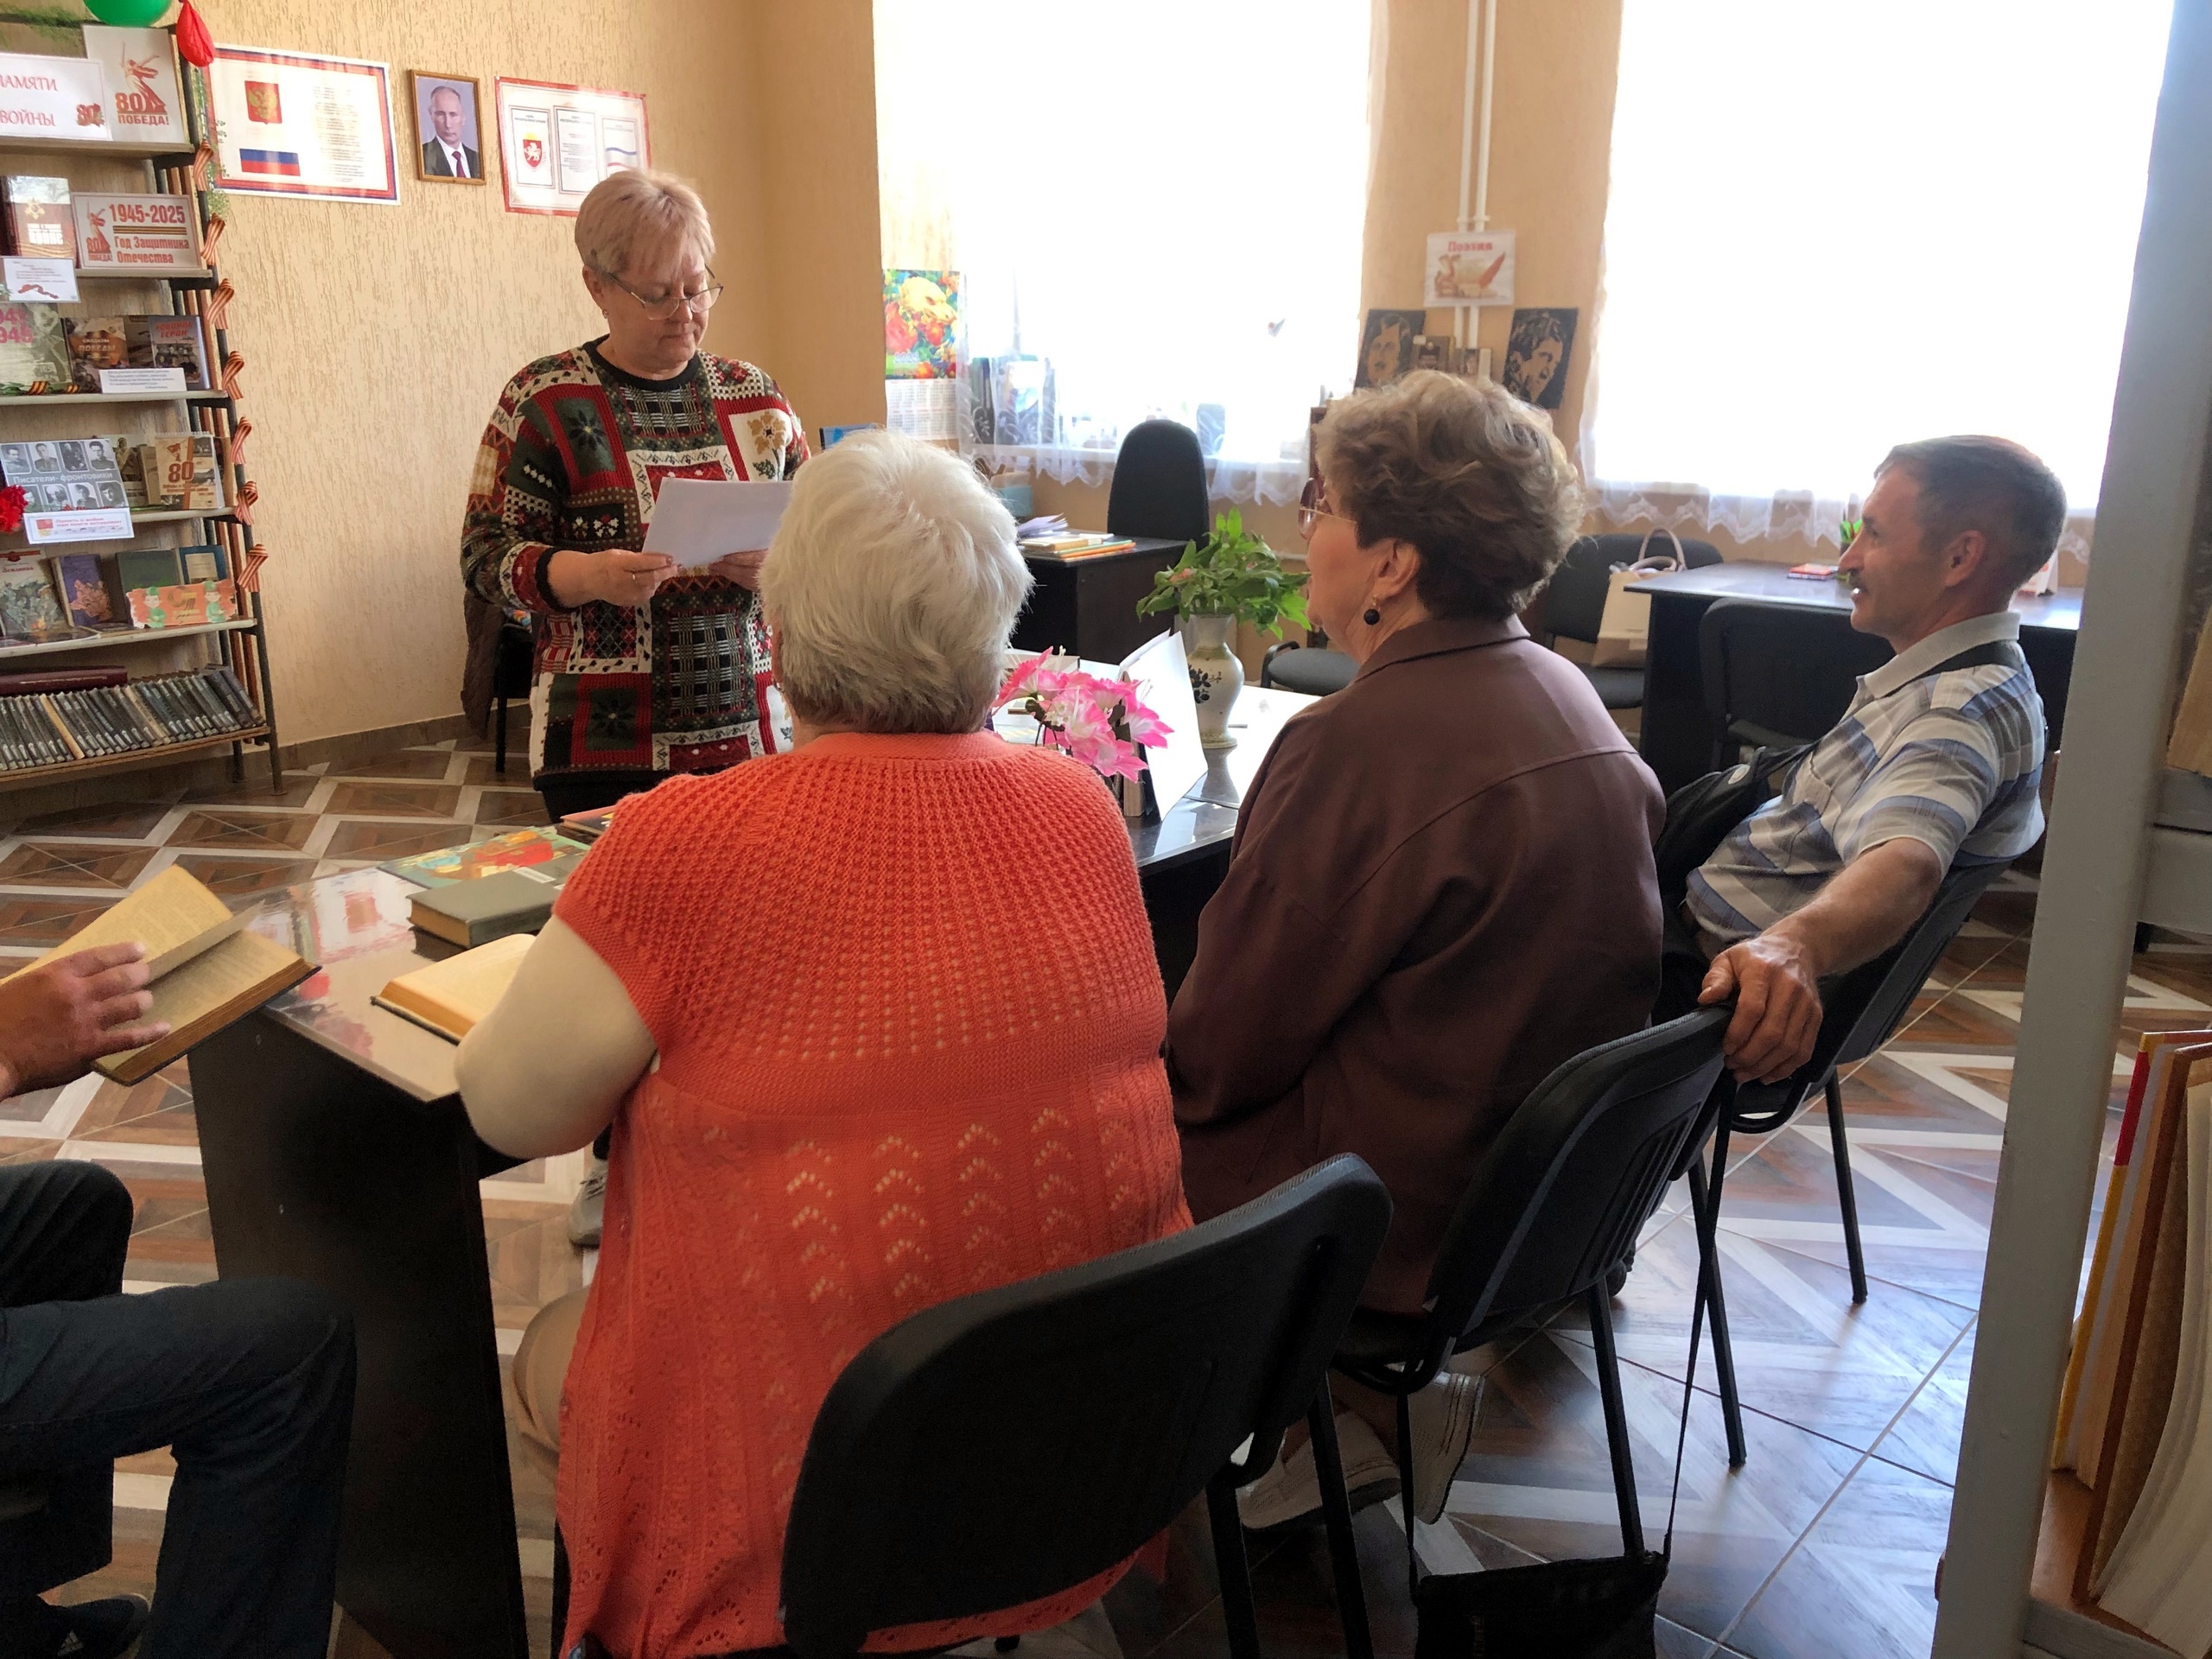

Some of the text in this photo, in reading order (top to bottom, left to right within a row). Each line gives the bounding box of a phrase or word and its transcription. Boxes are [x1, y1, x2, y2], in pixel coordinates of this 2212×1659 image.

[115, 92, 143, 111] 80
[0, 109, 56, 126] ВОЙНЫ
[118, 114, 169, 126] ПОБЕДА!
[109, 203, 186, 224] 1945-2025
[114, 236, 189, 250] Год Защитника
[1448, 240, 1493, 252] Поэзия
[117, 251, 174, 264] Отечества
[0, 327, 34, 344] 945
[60, 472, 113, 483] фронтовики
[168, 461, 194, 484] 80
